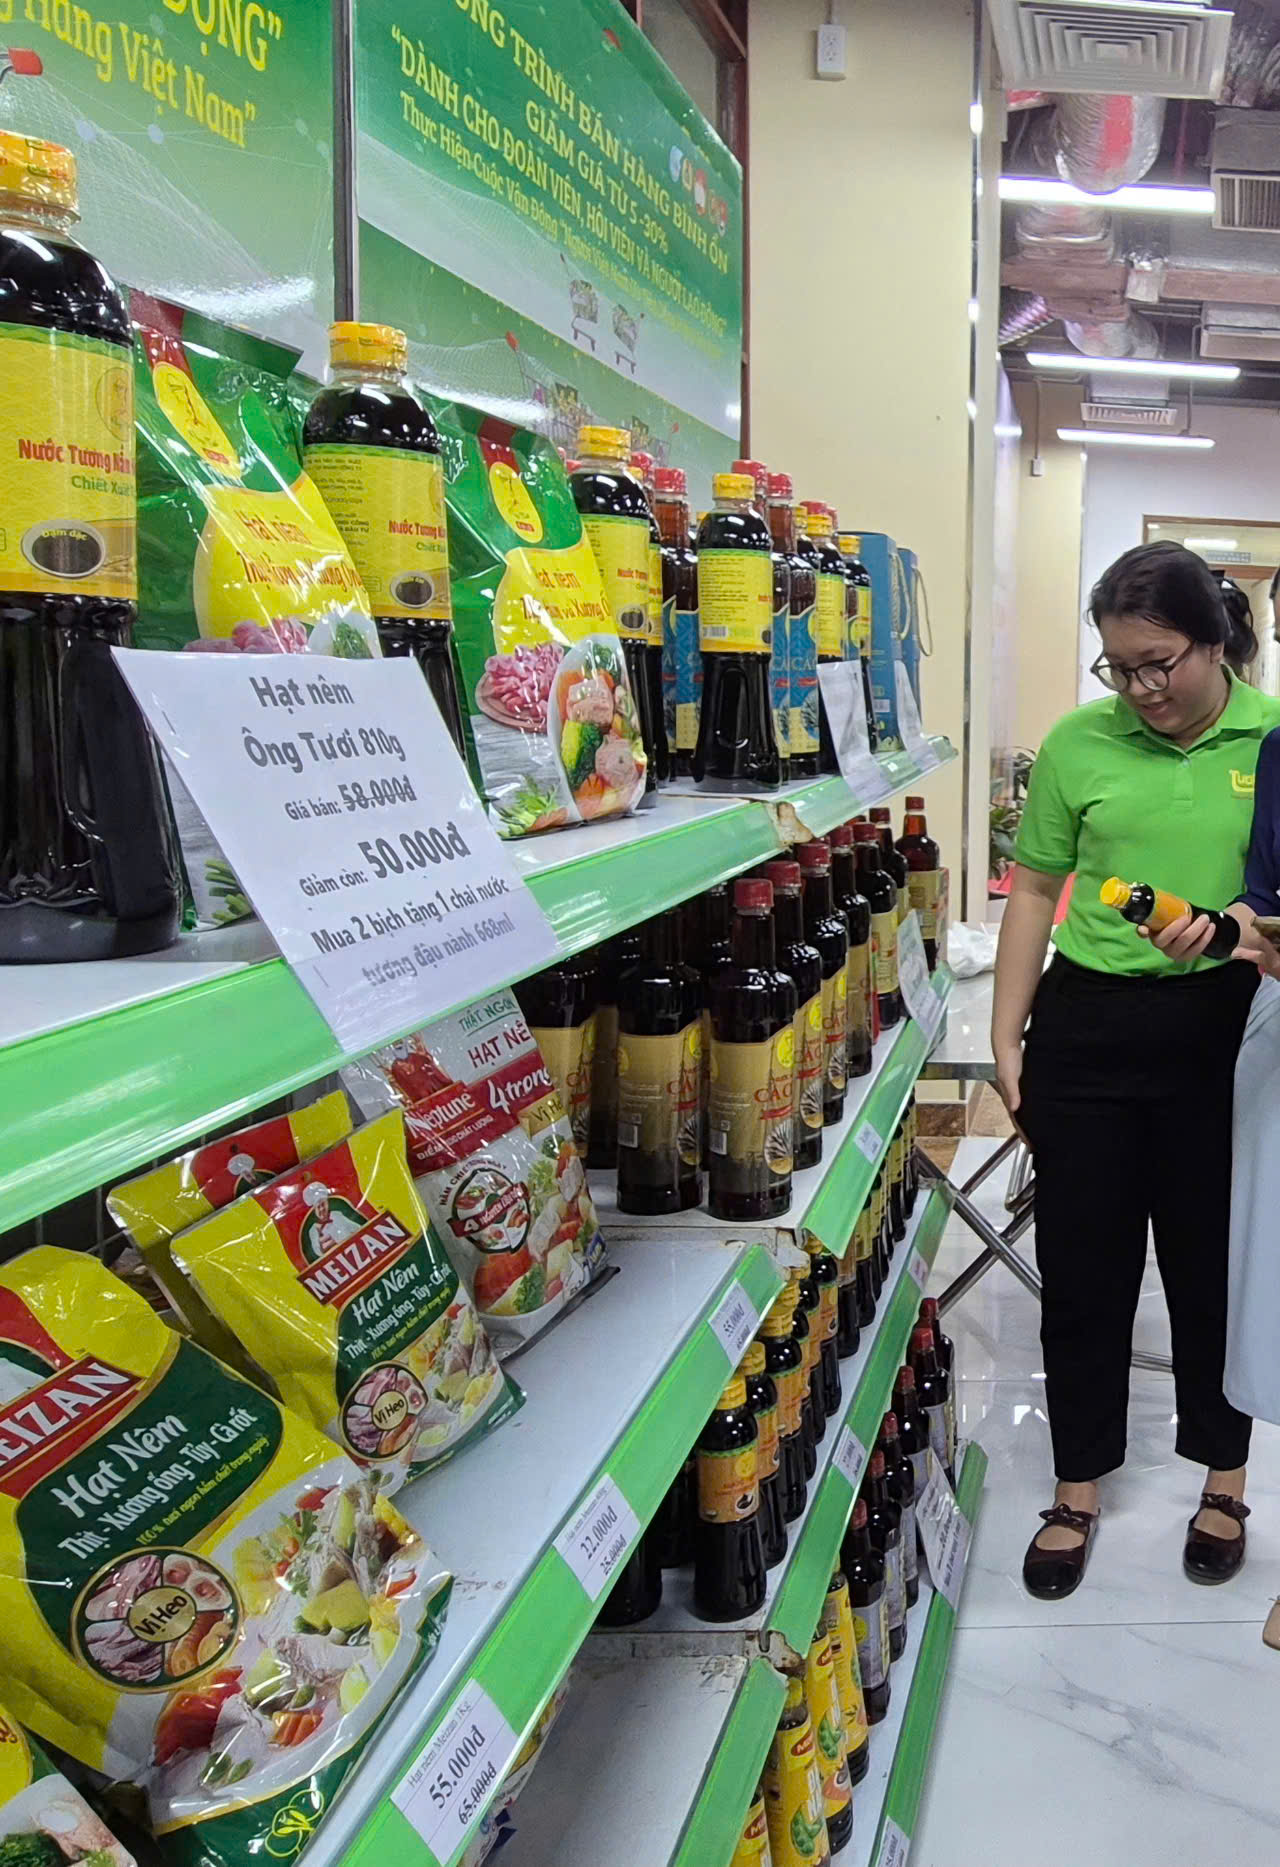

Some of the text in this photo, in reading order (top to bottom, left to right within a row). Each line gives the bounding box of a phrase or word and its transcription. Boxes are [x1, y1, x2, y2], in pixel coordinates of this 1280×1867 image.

[119, 22, 178, 115] Việt
[400, 91, 437, 144] Thực
[473, 152, 505, 196] Cuộc
[510, 27, 575, 120] TRÌNH
[578, 100, 619, 165] BÁN
[623, 150, 670, 216] HÀNG
[672, 201, 707, 255] BÌNH
[525, 100, 575, 168] GIẢM
[577, 150, 606, 197] GIÁ
[607, 174, 628, 216] TỪ
[629, 201, 638, 224] 5
[462, 94, 500, 150] CHO
[503, 127, 547, 191] ĐOÀN
[586, 201, 608, 245] HỘI
[609, 221, 637, 263] VIÊN
[636, 245, 651, 281] VÀ
[18, 438, 64, 462] Nước
[67, 444, 112, 474] Tương
[249, 674, 355, 716] Hạt nêm
[240, 726, 407, 774] Ông Tươi 810g
[284, 774, 418, 821] Giá bán: 58.000đ
[298, 820, 472, 898] Giảm còn: 50.000đ
[310, 878, 510, 955] Mua 2 bịch tặng 1 chai nước
[361, 910, 516, 988] tương đậu nành 668ml
[468, 1035, 500, 1068] HẠT
[404, 1092, 476, 1139] Neptune
[303, 1218, 407, 1301] MEIZAN
[352, 1263, 421, 1326] Hạt Nêm
[344, 1339, 368, 1360] Thịt
[366, 1313, 399, 1340] Xương
[0, 1361, 130, 1468] EIZAN
[374, 1399, 405, 1424] Vị Heo
[51, 1415, 189, 1519] Hạt Nêm
[57, 1530, 110, 1561] Thịt
[97, 1486, 170, 1532] Xương
[147, 1462, 196, 1491] ống
[209, 1422, 241, 1444] Cà
[228, 1406, 259, 1432] rốt
[134, 1595, 188, 1636] Vị Heo
[429, 1724, 487, 1810] 55.000đ
[458, 1760, 498, 1826] 65.000đ
